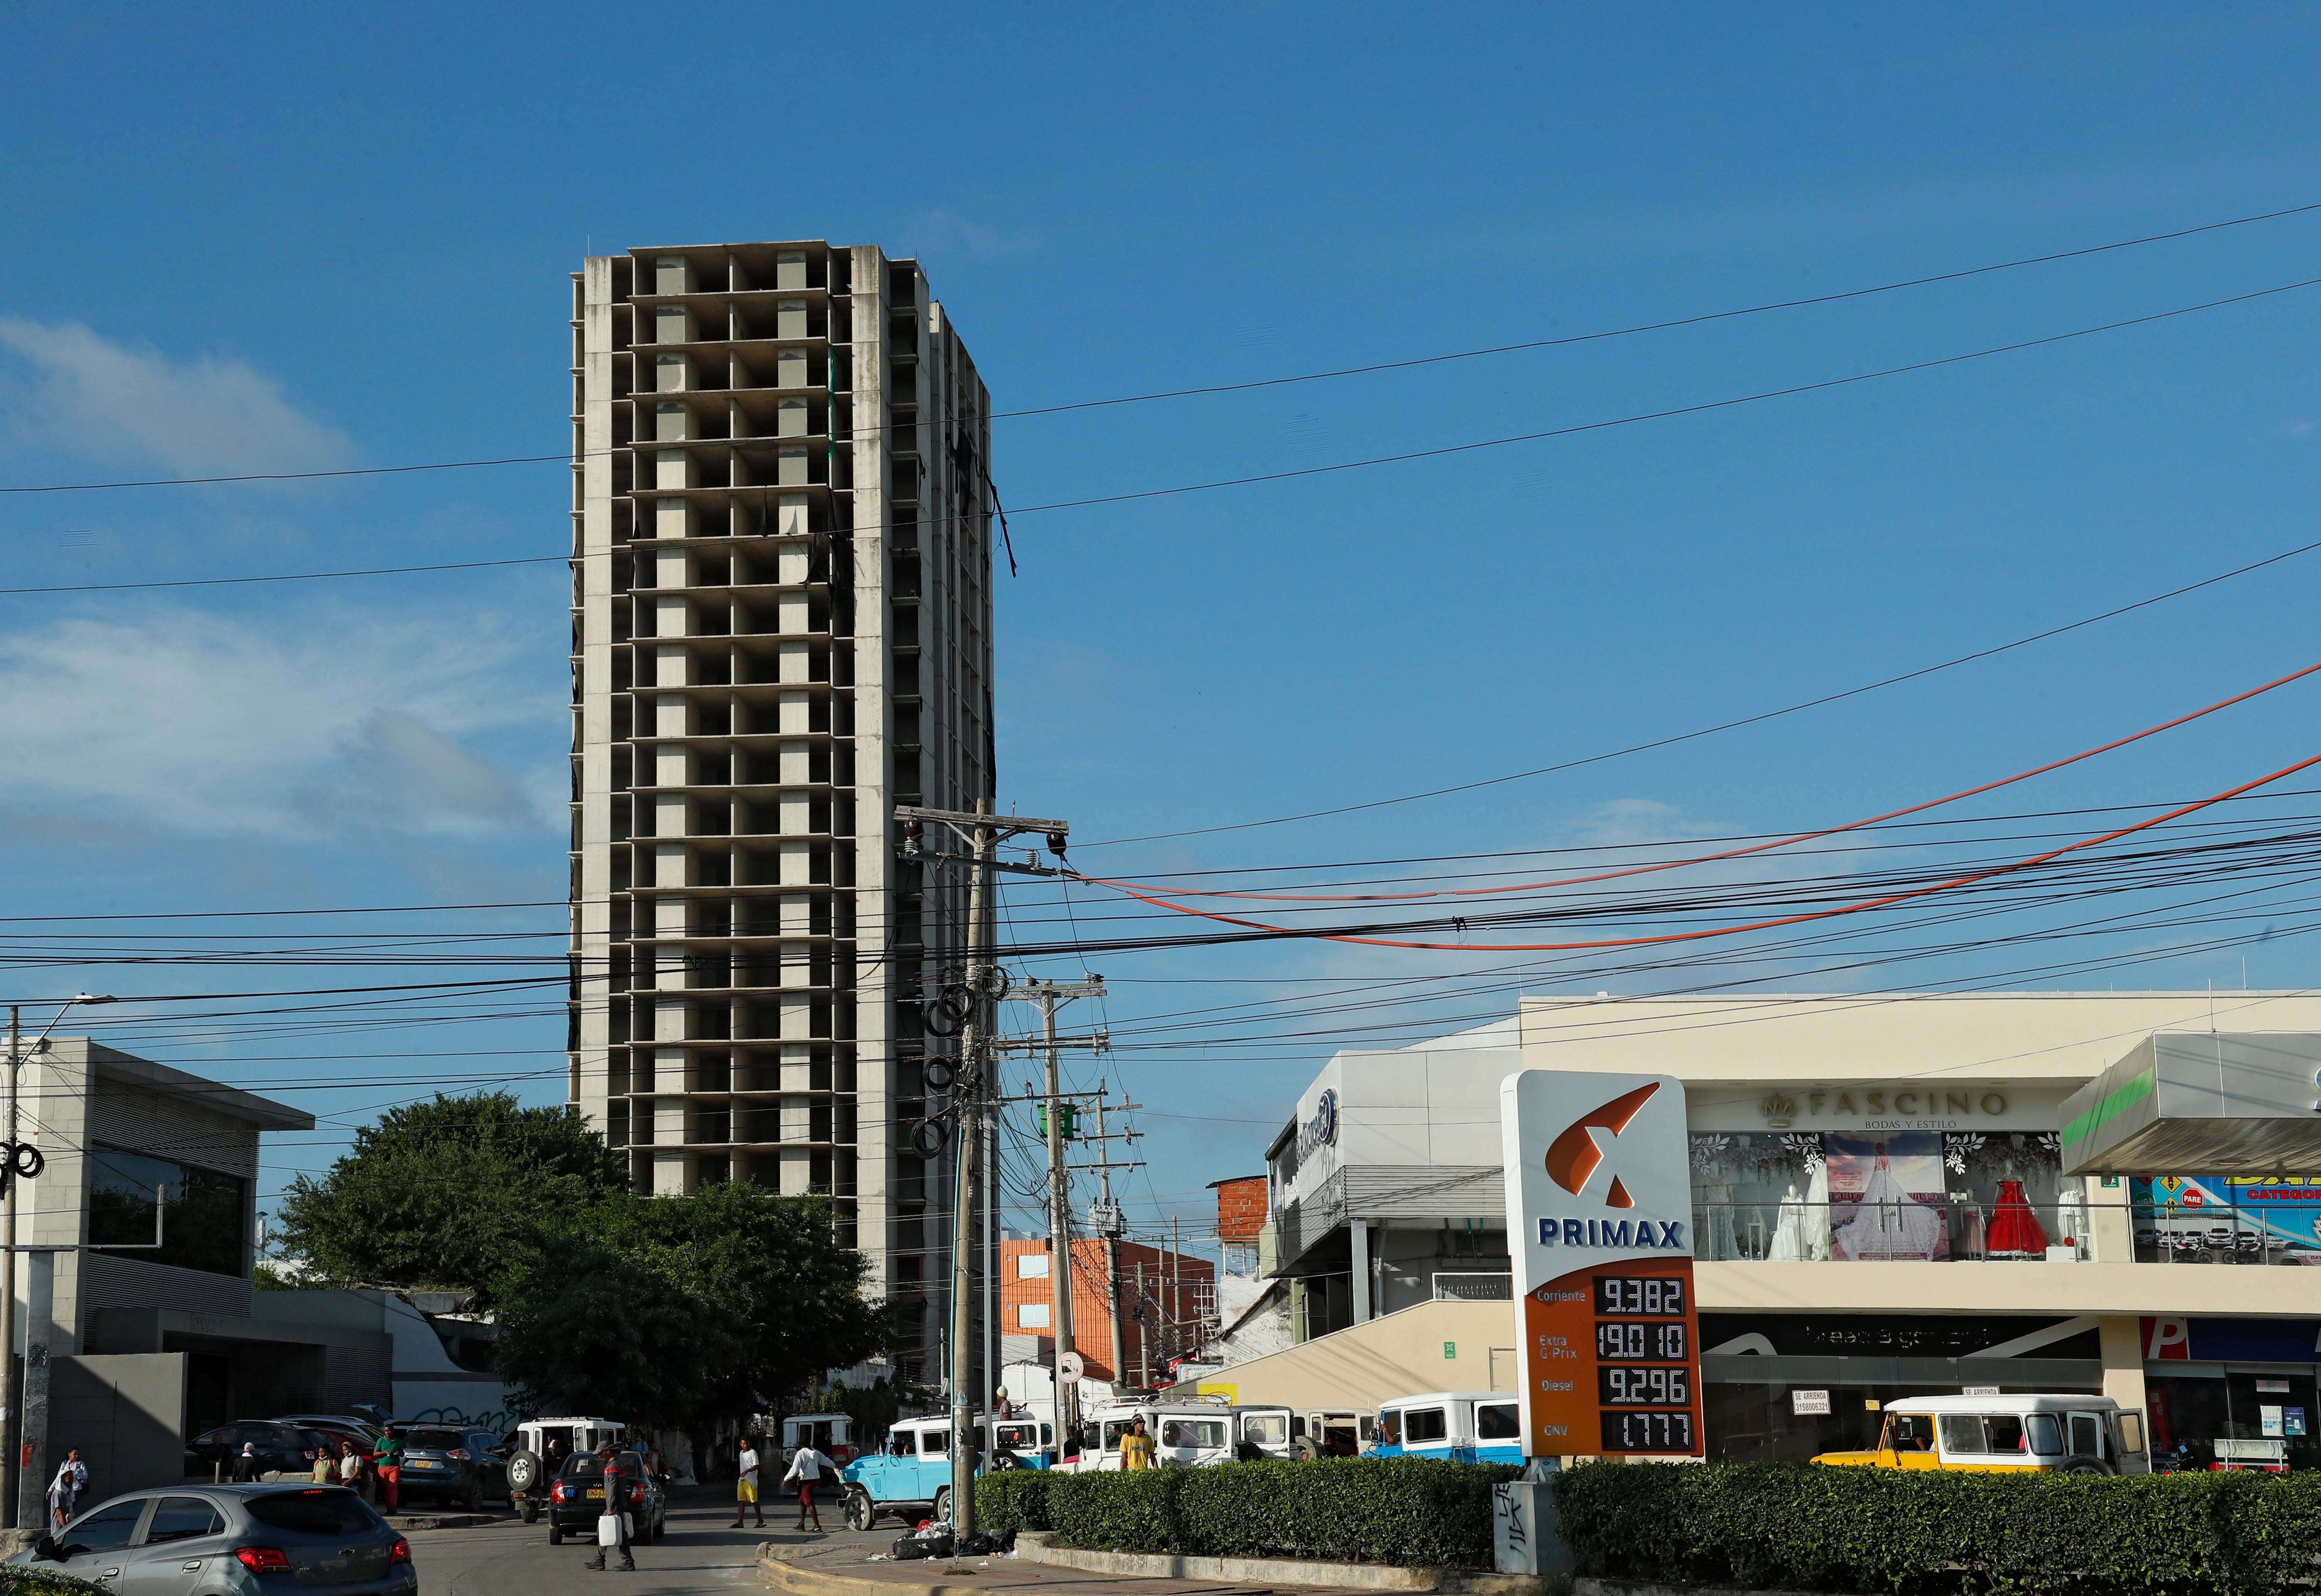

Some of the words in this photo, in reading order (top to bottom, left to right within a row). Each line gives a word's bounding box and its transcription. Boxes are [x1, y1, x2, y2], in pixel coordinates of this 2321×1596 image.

[1810, 1092, 2007, 1115] FASCINO
[1865, 1120, 1901, 1129] BODAS
[1917, 1120, 1957, 1129] ESTILO
[1537, 1218, 1680, 1247] PRIMAX
[1537, 1290, 1586, 1301] Corriente
[1605, 1279, 1680, 1313] 9.382
[1540, 1335, 1567, 1346] Extra
[1540, 1347, 1577, 1359] G-Prix
[1542, 1380, 1573, 1391] Diesel
[1610, 1370, 1686, 1402] 9.296
[1796, 1402, 1828, 1412] 3158006321
[1544, 1424, 1568, 1436] GNV
[1624, 1414, 1689, 1447] 1.777
